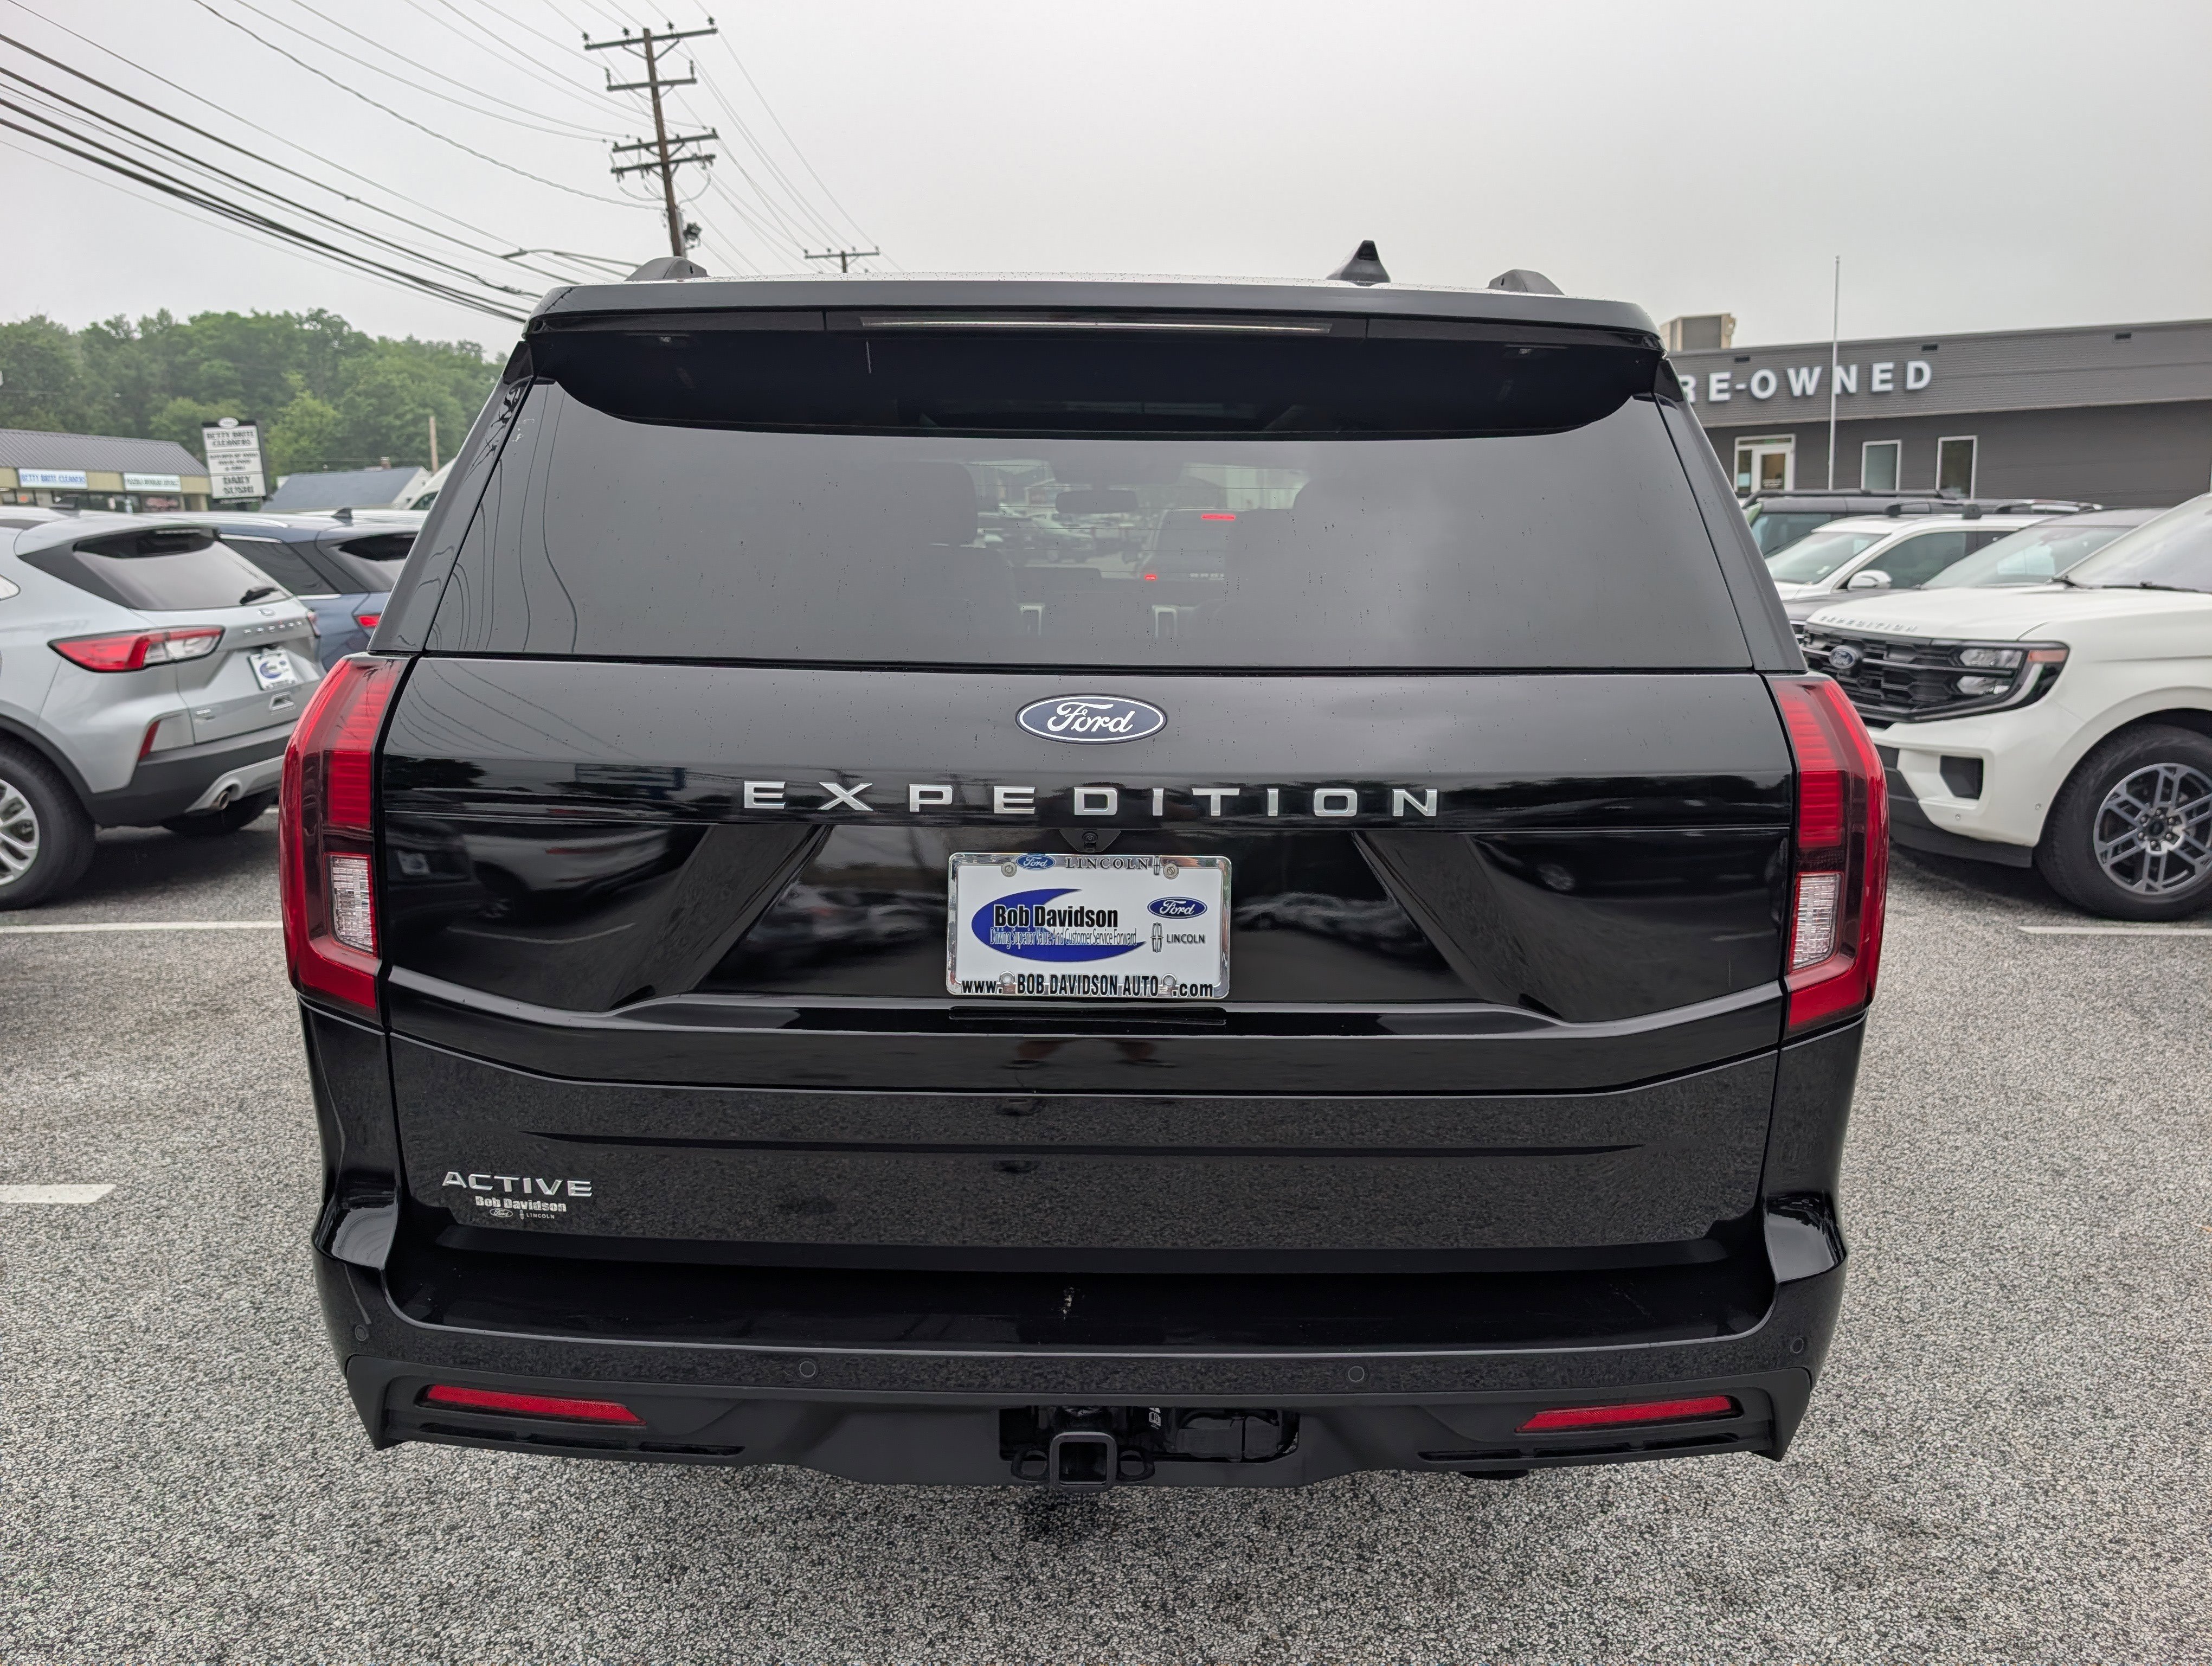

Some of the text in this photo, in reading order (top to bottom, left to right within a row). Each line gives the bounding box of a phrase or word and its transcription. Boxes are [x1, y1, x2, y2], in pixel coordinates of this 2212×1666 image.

[1677, 360, 1932, 403] RE-OWNED
[1047, 701, 1136, 733] Ford
[744, 780, 1438, 817] EXPEDITION
[1065, 857, 1149, 869] LINCOLN
[994, 905, 1118, 928] Bob Davidson
[1159, 900, 1195, 915] Ford
[990, 927, 1137, 949] Driving Superior Value And Customer Service Forward
[1166, 933, 1206, 944] LINCOLN
[962, 973, 1214, 997] www. BOB DAVIDSON AUTO .com
[442, 1171, 593, 1197] ACTIVE
[475, 1195, 567, 1212] Bob Davidson
